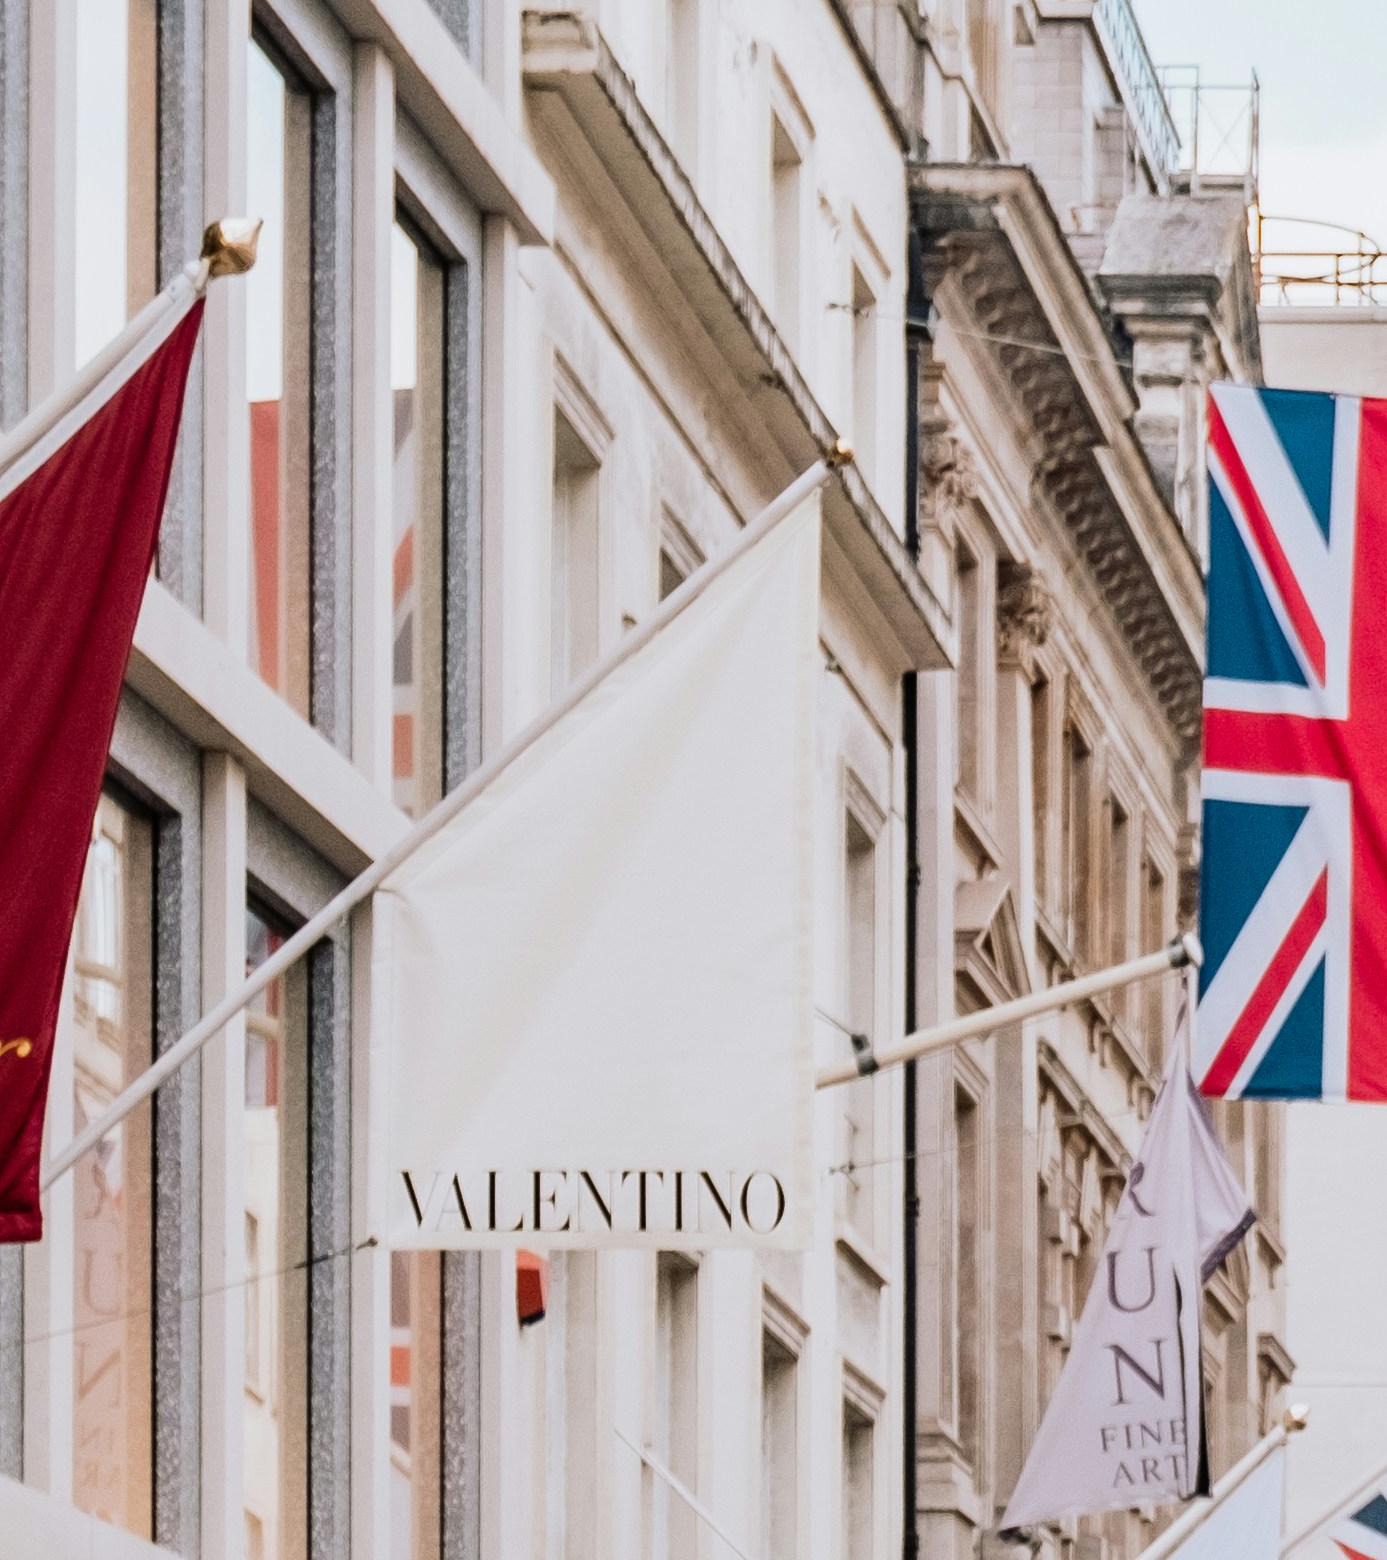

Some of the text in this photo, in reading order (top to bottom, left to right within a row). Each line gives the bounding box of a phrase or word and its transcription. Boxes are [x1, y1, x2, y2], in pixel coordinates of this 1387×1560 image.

[399, 1169, 787, 1234] VALENTINO
[1100, 1418, 1187, 1454] FINE
[1113, 1453, 1186, 1487] ART
